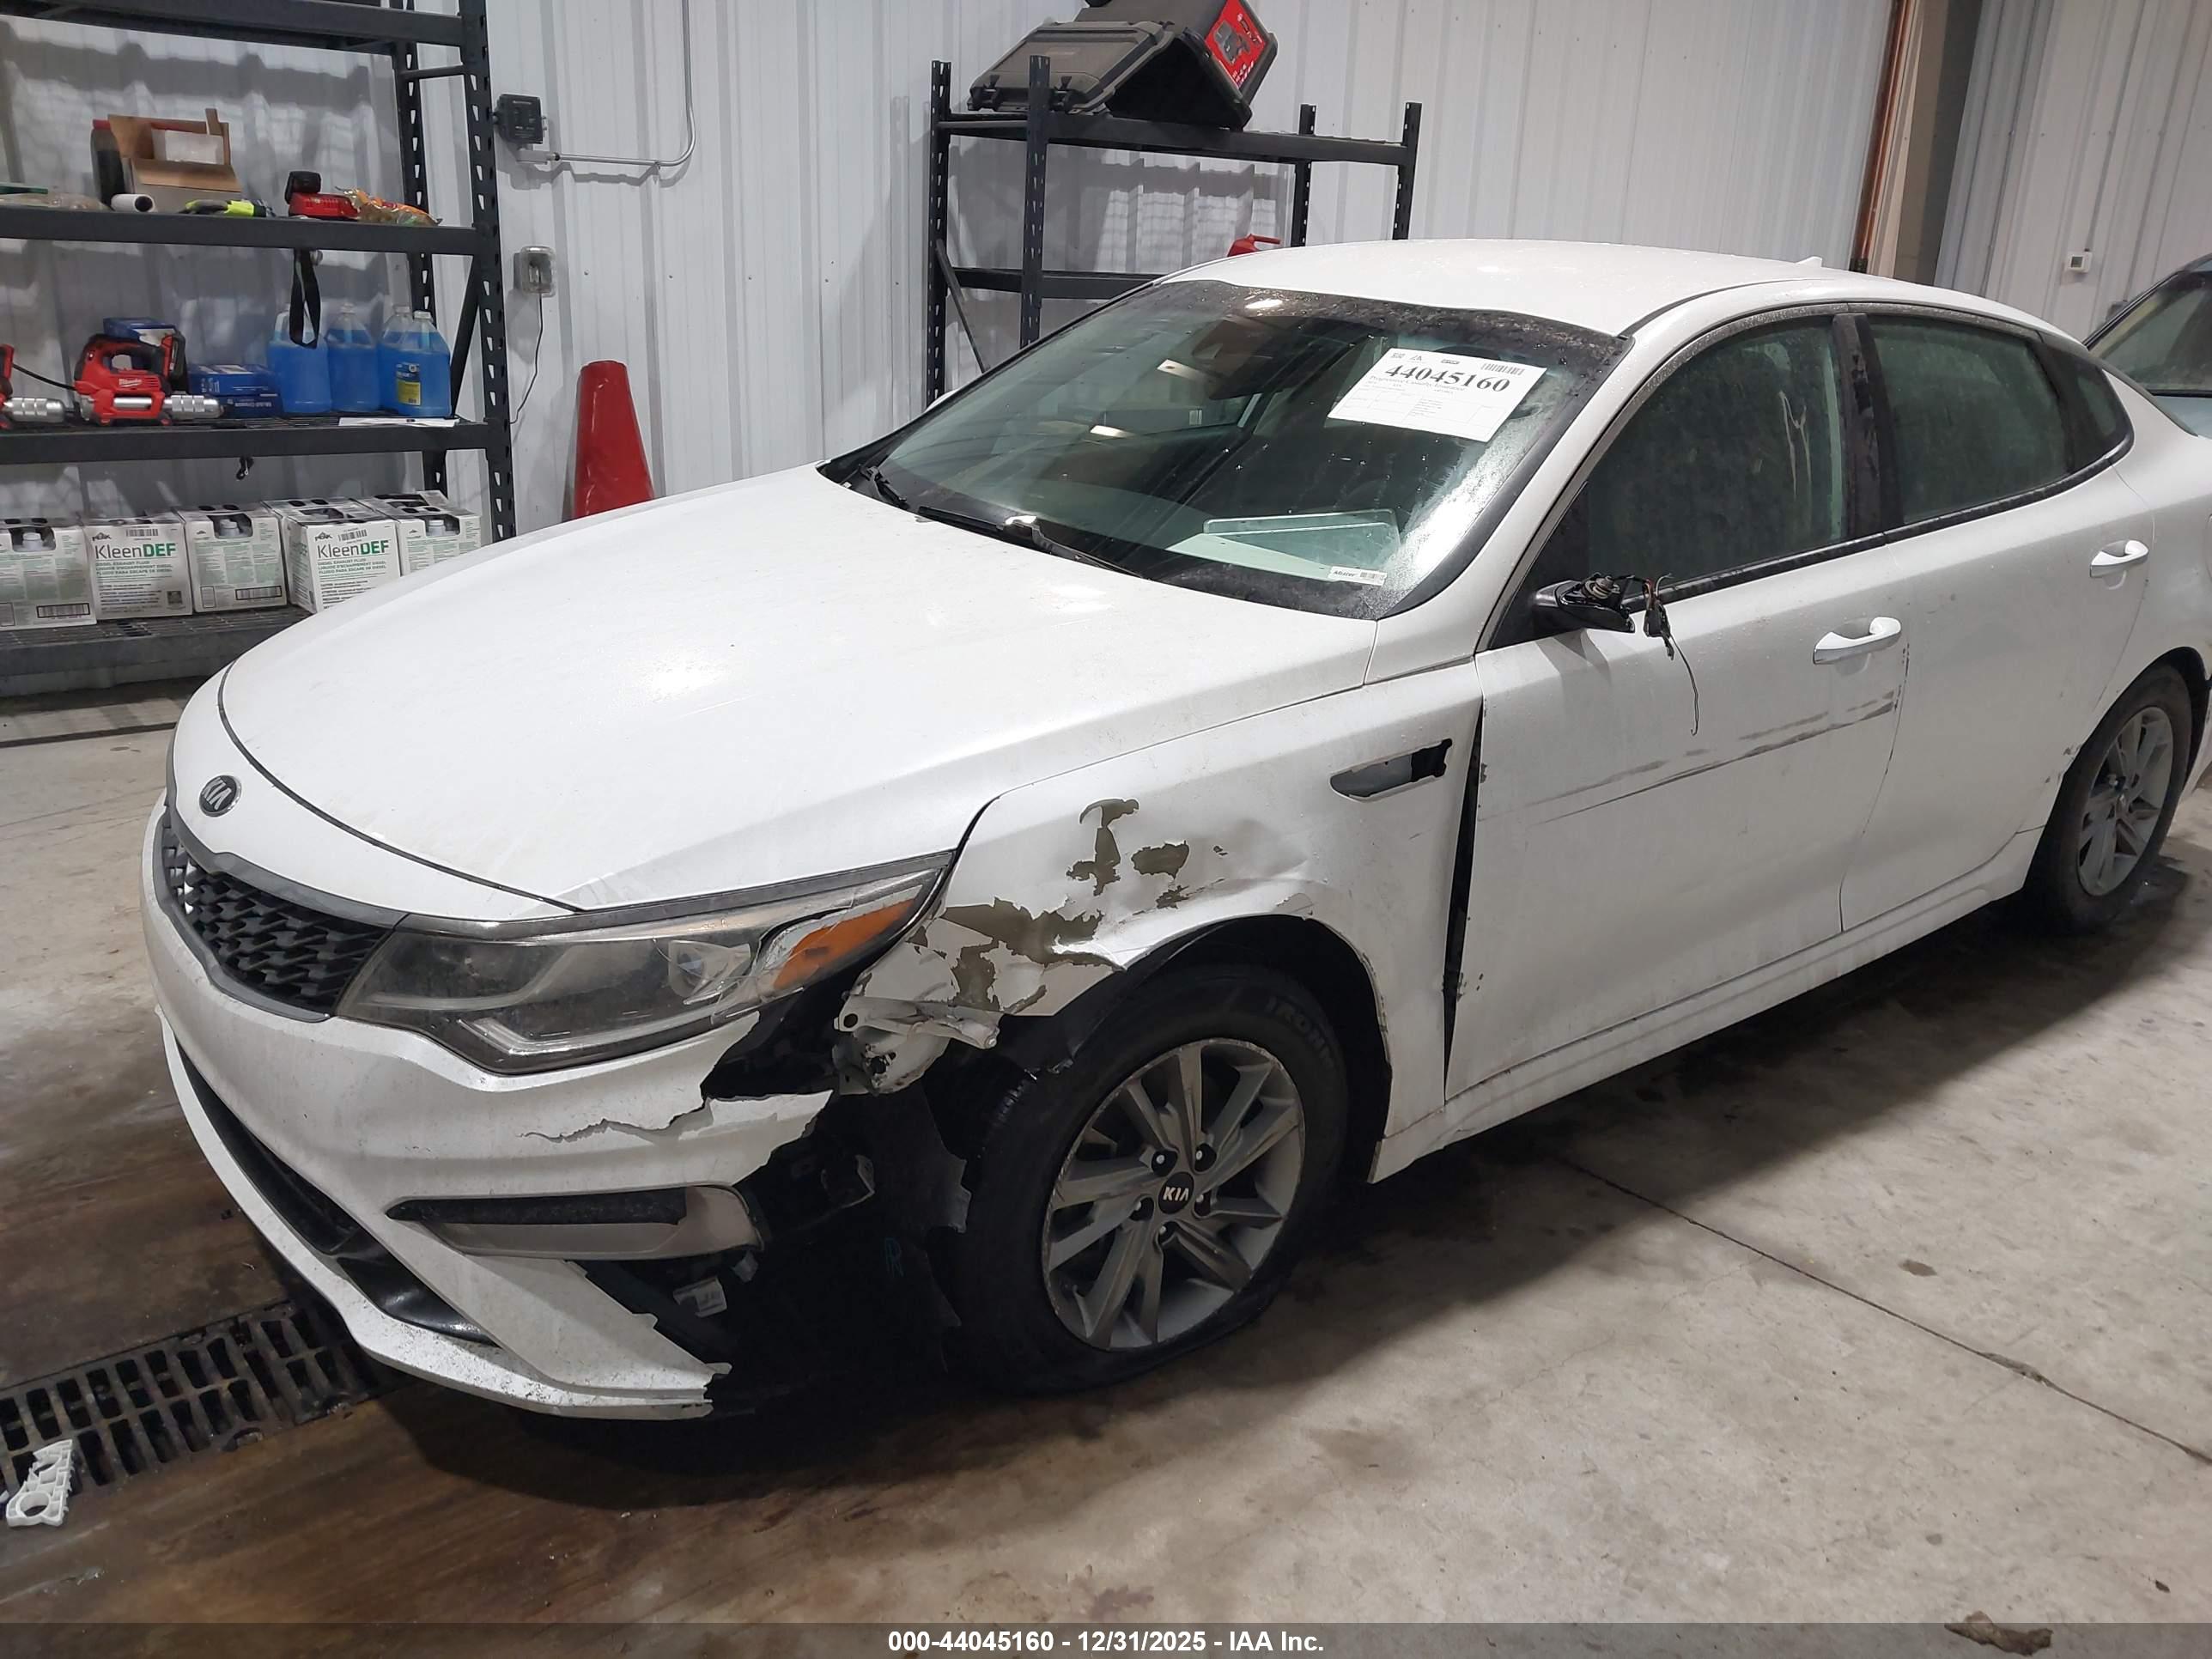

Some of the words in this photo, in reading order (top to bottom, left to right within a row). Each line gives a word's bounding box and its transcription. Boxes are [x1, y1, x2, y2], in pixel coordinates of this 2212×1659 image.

[1385, 365, 1510, 392] 44045160
[94, 543, 176, 559] KleenDEF
[317, 540, 389, 558] KleenDEF
[1163, 1186, 1189, 1201] KIA
